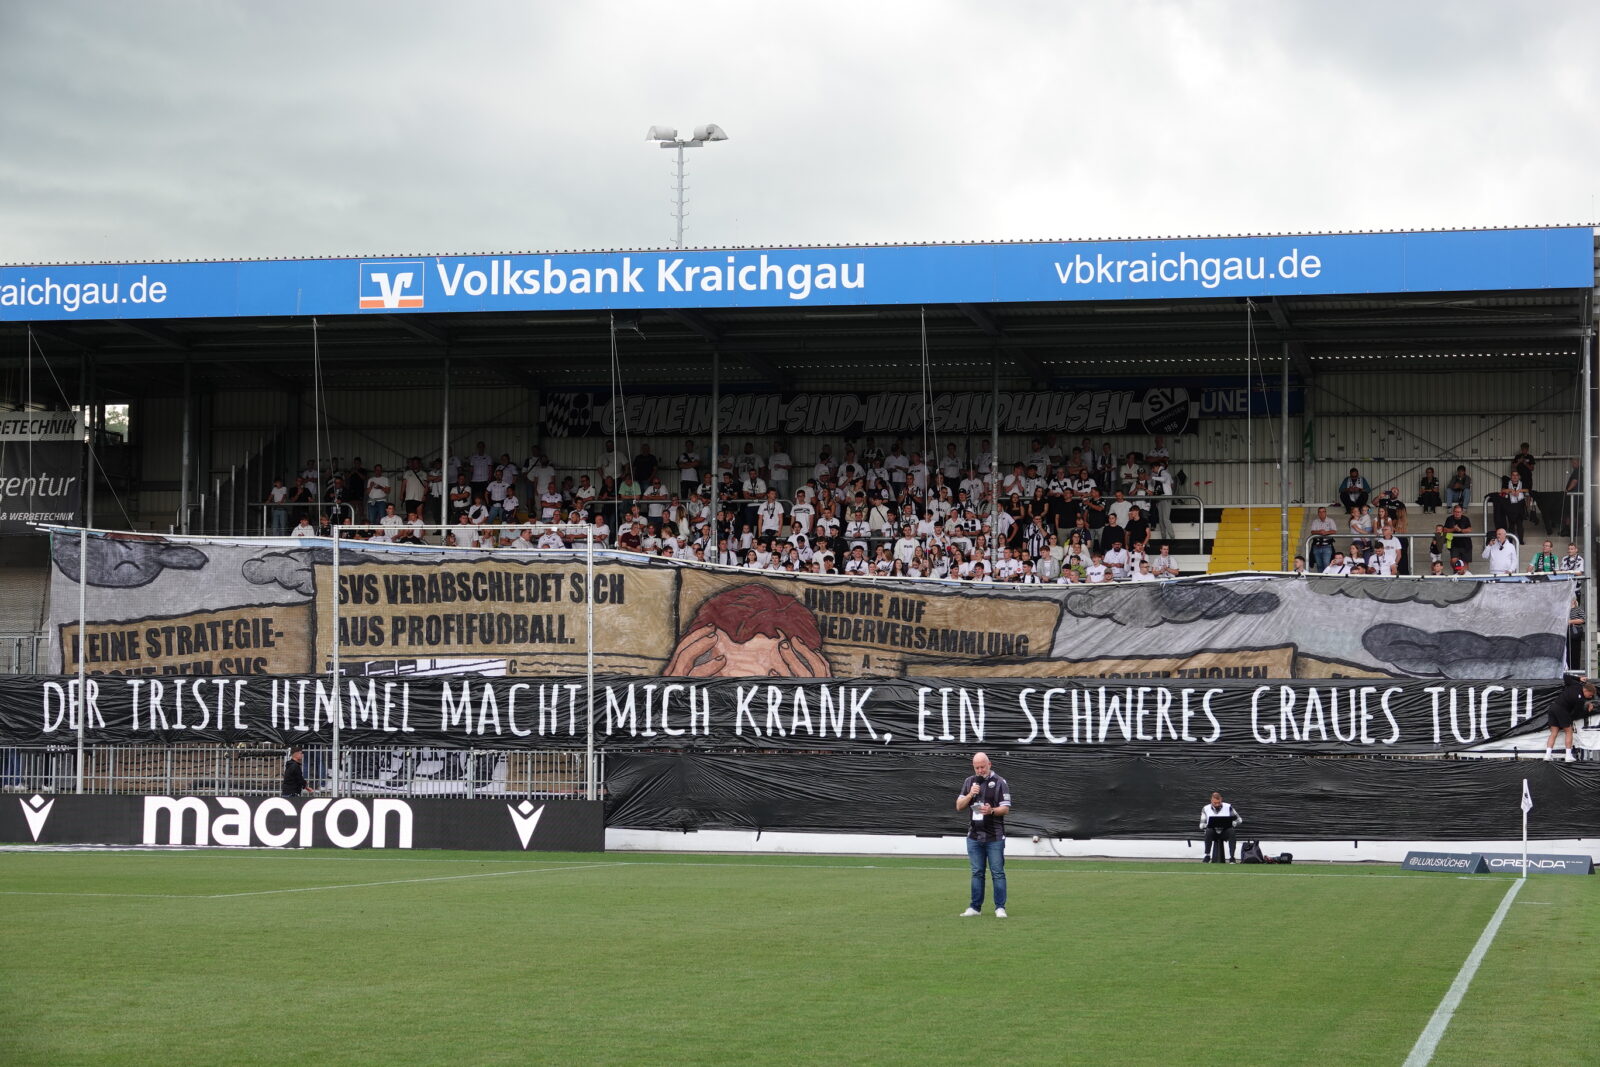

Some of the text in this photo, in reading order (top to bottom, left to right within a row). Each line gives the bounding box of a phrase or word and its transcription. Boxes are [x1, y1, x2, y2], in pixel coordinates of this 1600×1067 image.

[436, 254, 865, 300] Volksbank Kraichgau
[1054, 248, 1321, 289] vbkraichgau.de
[0, 275, 167, 312] aichgau.de
[0, 419, 77, 435] ETECHNIK
[600, 390, 1134, 435] GEMEINSAM SIND WIR SANDHAUSEN
[338, 571, 625, 605] SVS VERABSCHIEDET SICH
[804, 588, 927, 624] UNRUHE AUF
[71, 617, 284, 664] KEINE STRATEGIE-
[338, 615, 385, 647] AUS
[43, 677, 1533, 745] DER TRISTE HIMMEL MACHT MICH KRANK, EIN SCHWERES GRAUES TUCH
[142, 795, 413, 848] macron
